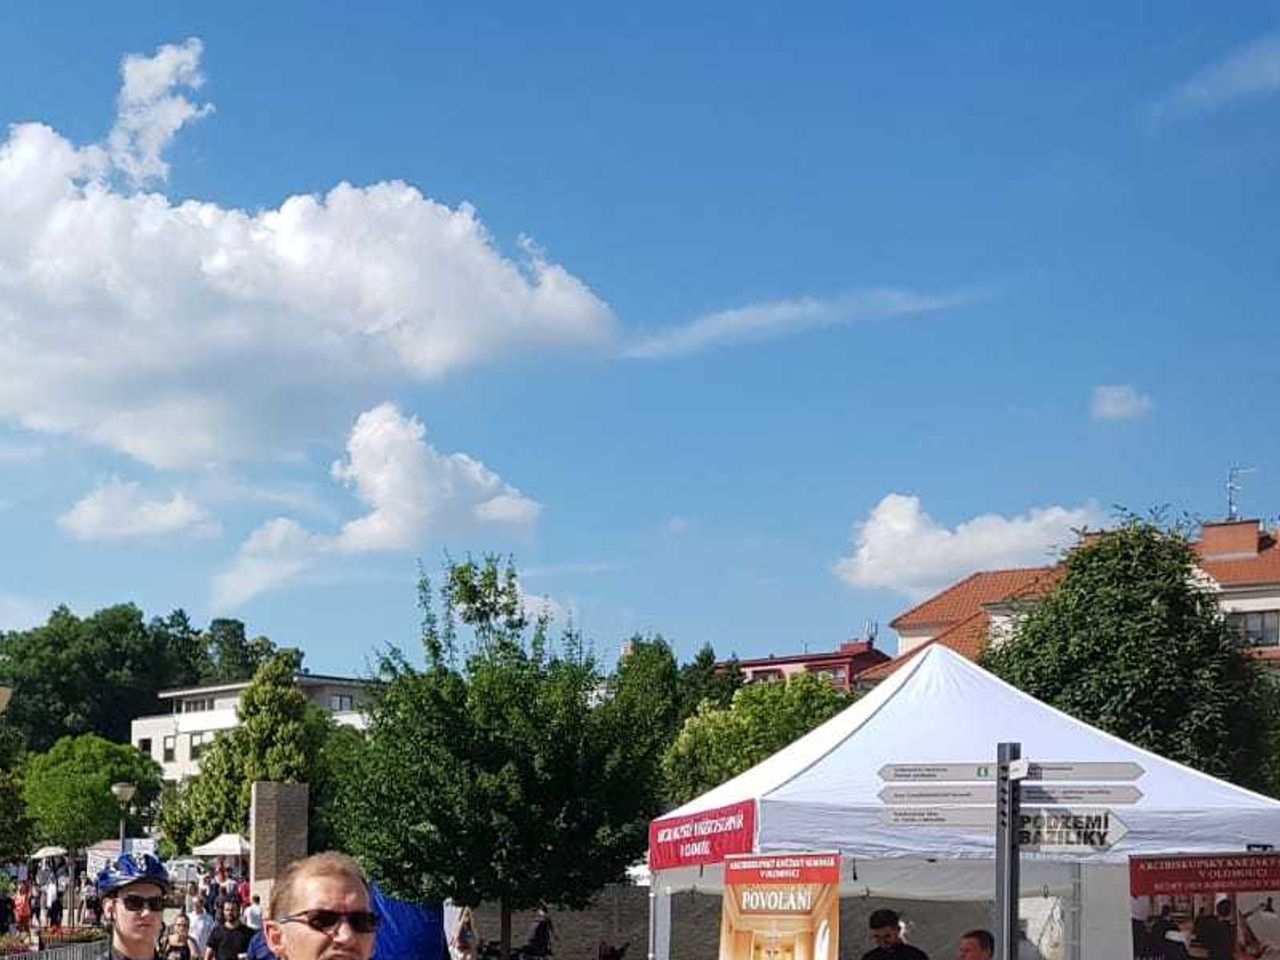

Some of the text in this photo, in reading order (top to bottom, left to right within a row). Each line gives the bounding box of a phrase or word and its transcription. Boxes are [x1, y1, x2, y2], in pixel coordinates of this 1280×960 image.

[1019, 812, 1110, 829] PODZEMÍ
[1019, 830, 1109, 846] BAZILIKY
[742, 886, 811, 911] POVOLÁNÍ
